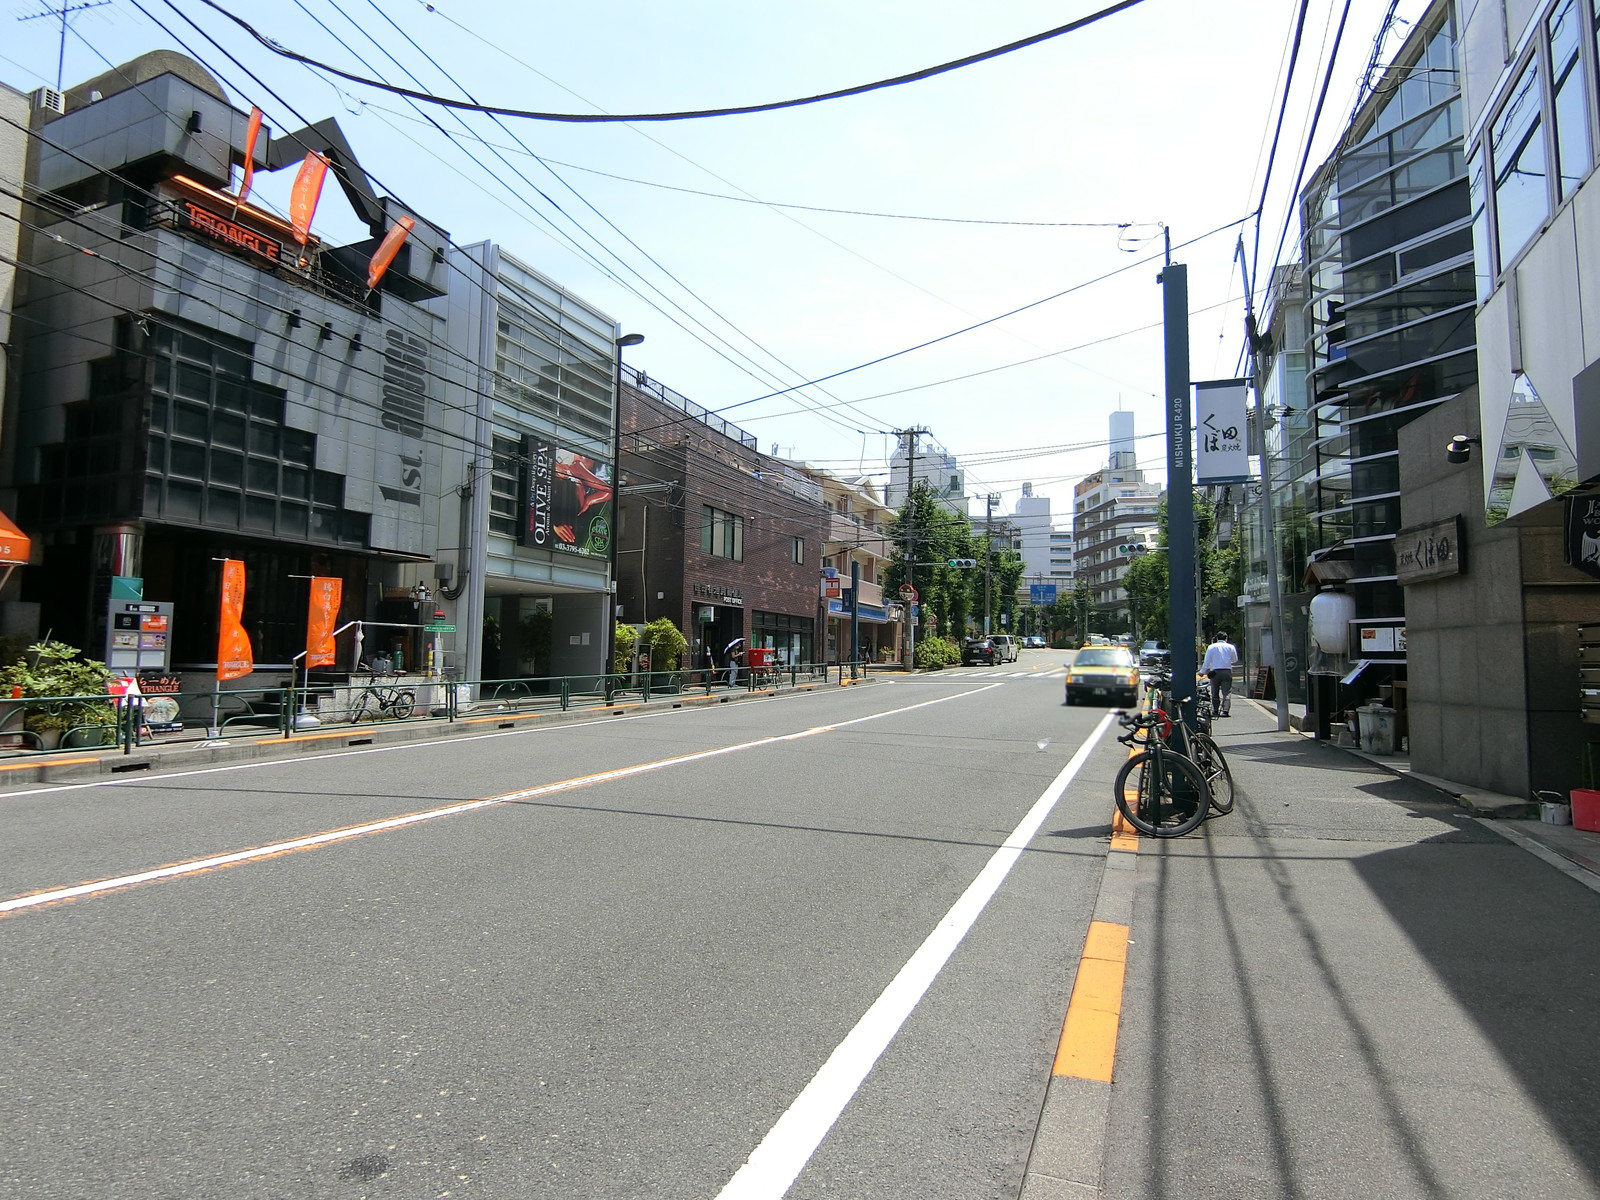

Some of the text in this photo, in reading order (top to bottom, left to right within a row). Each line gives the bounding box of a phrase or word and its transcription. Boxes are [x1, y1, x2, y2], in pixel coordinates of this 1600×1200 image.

[1174, 423, 1184, 468] MISHUKU
[378, 450, 423, 507] 1st.
[535, 446, 549, 545] OLIVE SPA
[1415, 533, 1450, 569] くぼ田
[140, 677, 180, 686] らーめん
[141, 685, 180, 693] TRIANGLE
